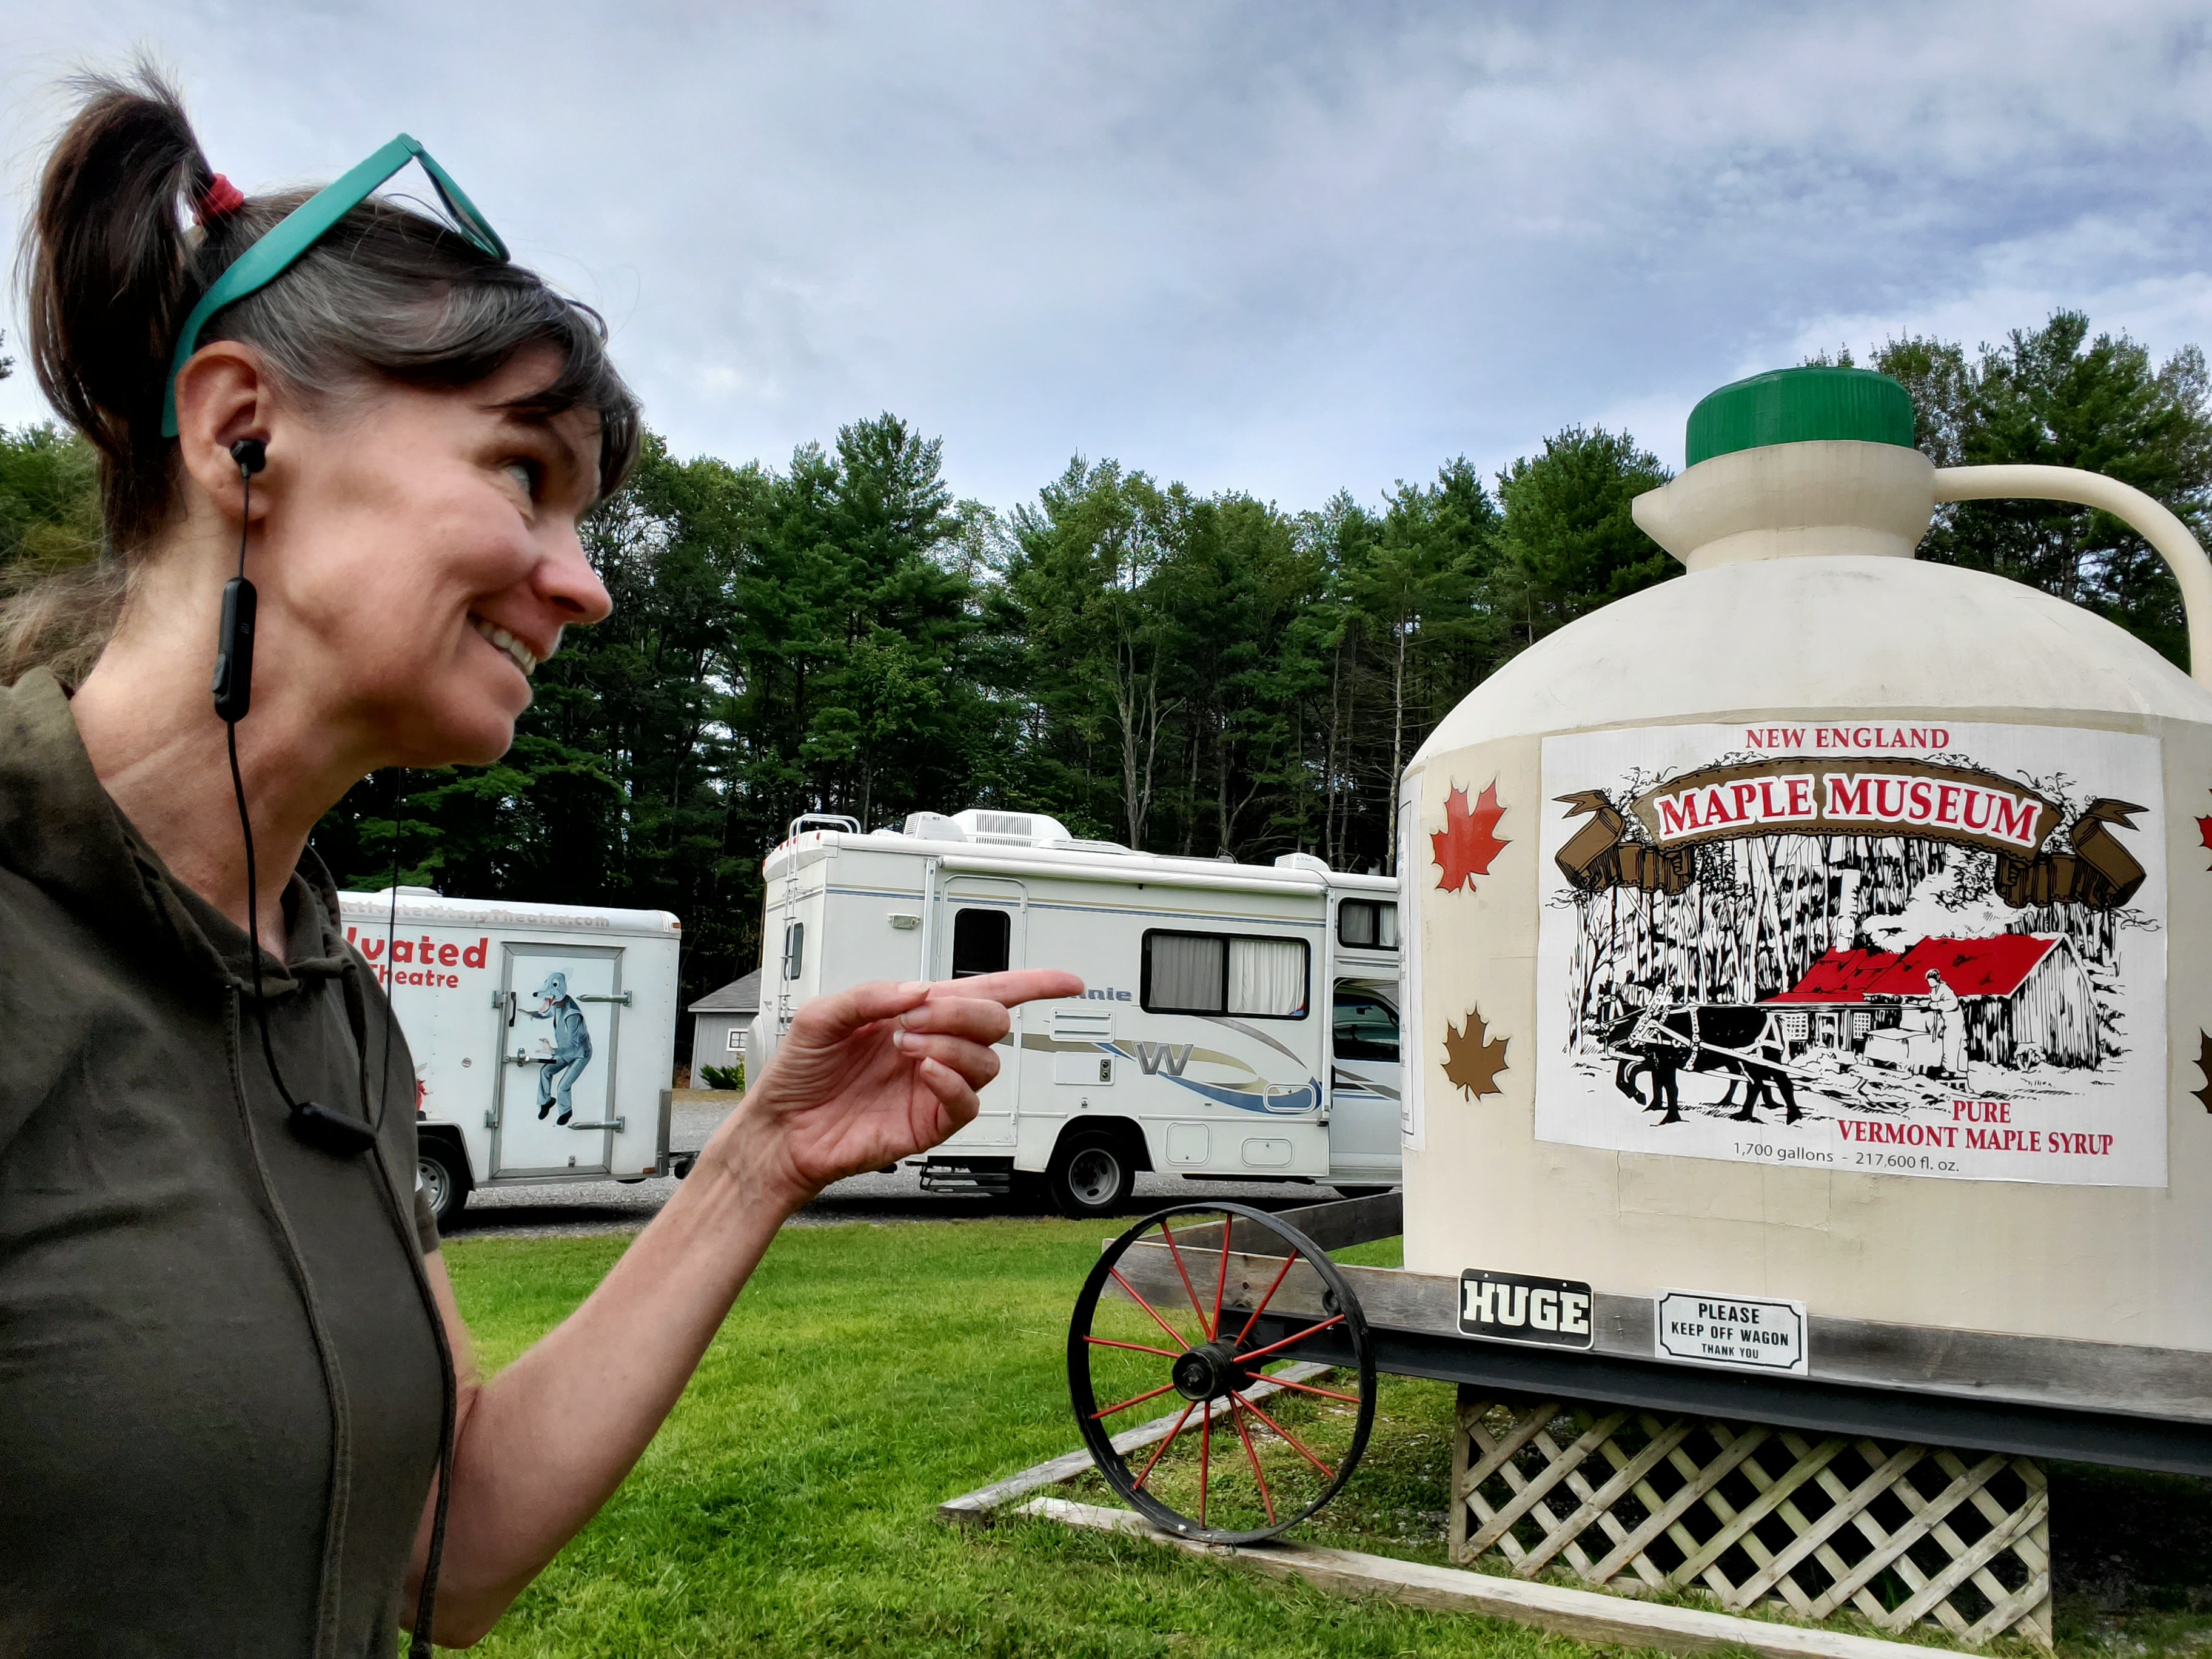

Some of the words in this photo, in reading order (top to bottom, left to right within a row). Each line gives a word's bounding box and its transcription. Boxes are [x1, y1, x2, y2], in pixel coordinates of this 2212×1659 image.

[1745, 728, 1806, 749] NEW
[1815, 727, 1949, 749] ENGLAND
[1659, 779, 1812, 836] MAPLE
[1828, 777, 2038, 842] MUSEUM
[1952, 1099, 2012, 1124] PURE
[1837, 1119, 1959, 1149] VERMONT
[1965, 1127, 2041, 1153] MAPLE
[2048, 1131, 2114, 1155] SYRUP
[1734, 1142, 1773, 1158] 1,700
[1777, 1146, 1834, 1163] gallons
[1855, 1151, 1916, 1170] 217,600
[1920, 1158, 1934, 1170] fl.
[1937, 1160, 1960, 1172] oz.
[1464, 1280, 1590, 1335] HUGE
[1698, 1302, 1760, 1324] PLEASE
[1671, 1321, 1704, 1337] KEEP
[1711, 1326, 1734, 1341] OFF
[1740, 1329, 1789, 1346] WAGON
[1701, 1342, 1735, 1357] THANK
[1740, 1347, 1759, 1359] YOU
